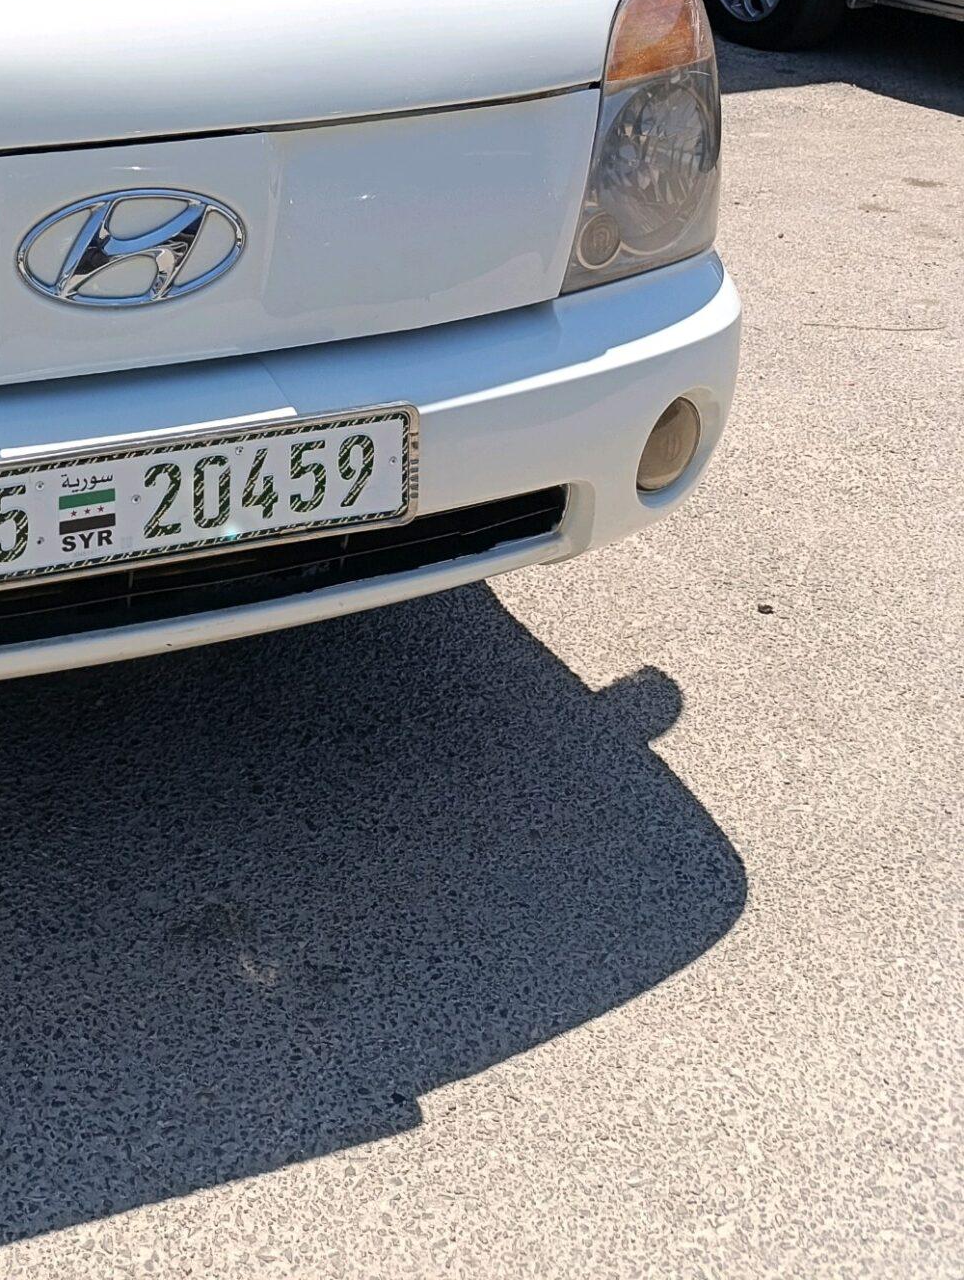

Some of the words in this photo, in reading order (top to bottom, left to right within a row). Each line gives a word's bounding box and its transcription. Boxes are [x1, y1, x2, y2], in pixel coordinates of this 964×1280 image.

[61, 471, 115, 492] سورية
[142, 433, 376, 540] 20459
[61, 528, 114, 553] SYR
